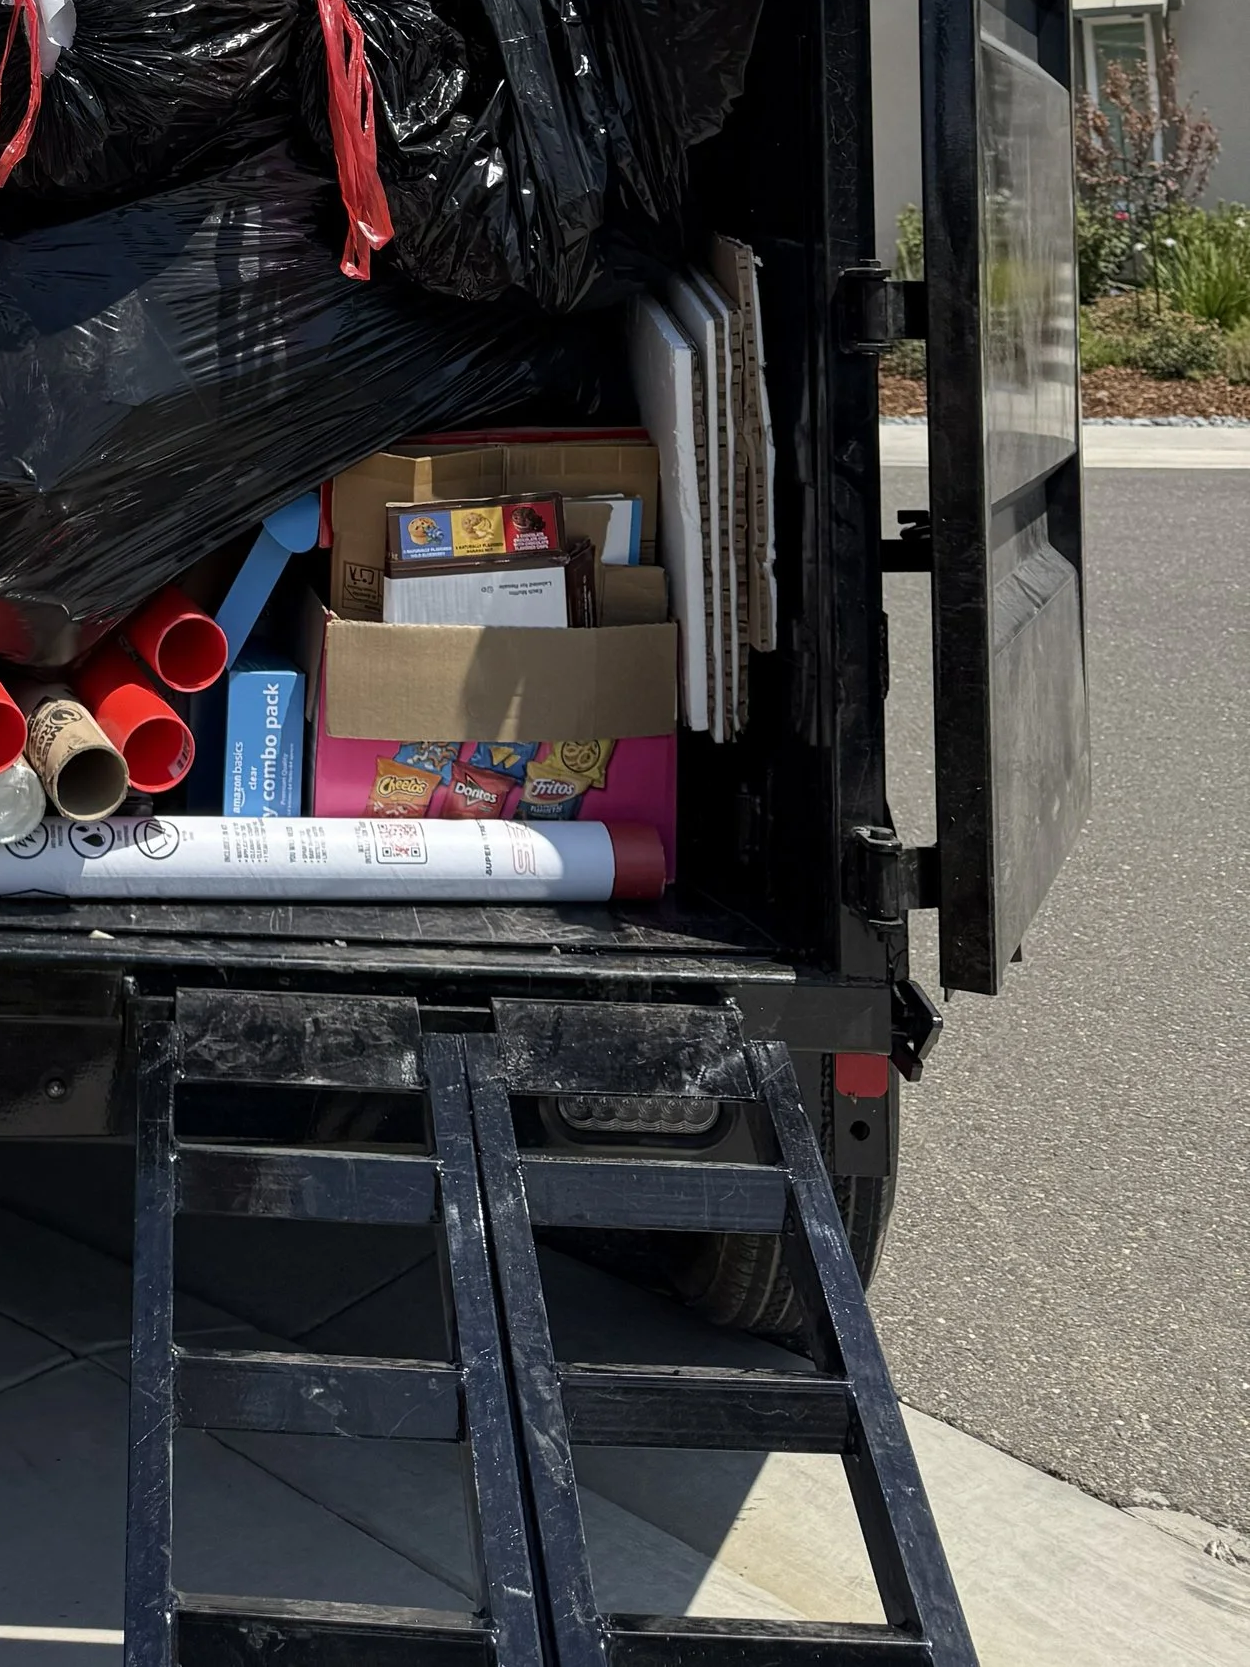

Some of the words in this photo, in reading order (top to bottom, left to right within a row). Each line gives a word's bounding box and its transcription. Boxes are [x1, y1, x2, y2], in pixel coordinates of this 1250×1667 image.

[263, 683, 282, 729] pack
[232, 741, 244, 774] basics
[260, 734, 278, 801] combo
[232, 774, 243, 814] amazon
[378, 775, 427, 795] Cheetos
[455, 782, 498, 803] Doritos
[532, 778, 575, 796] Fritos
